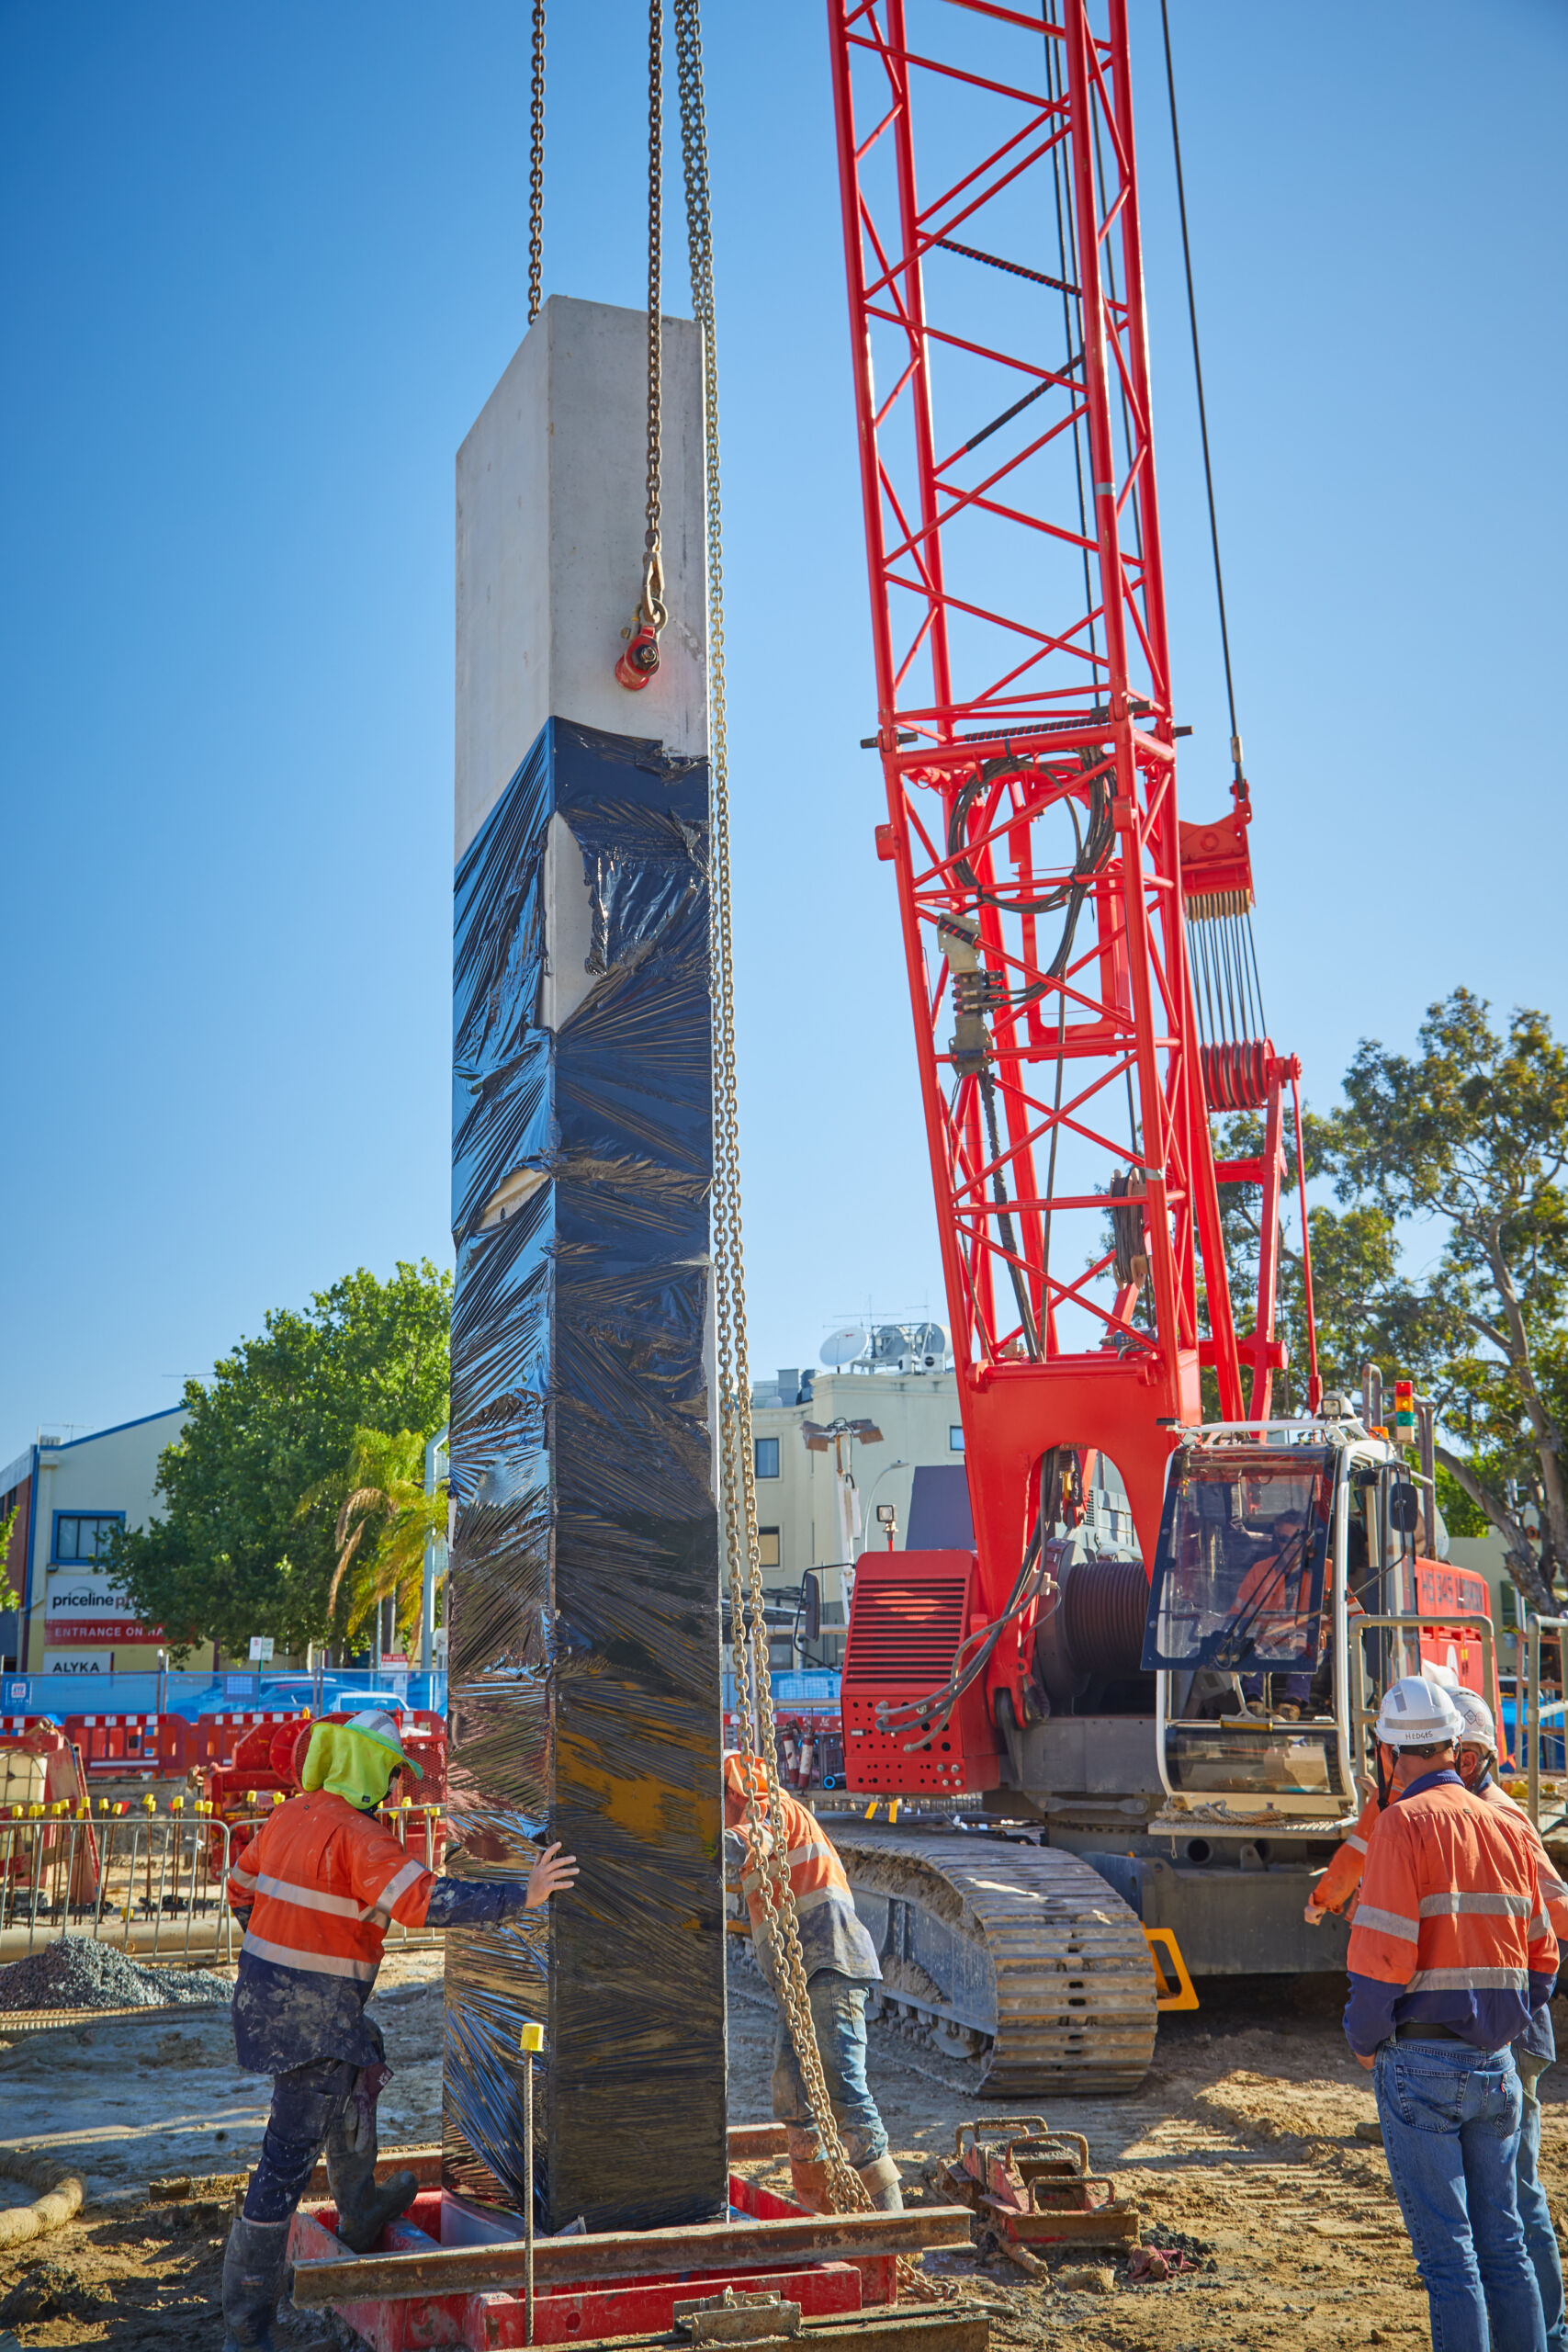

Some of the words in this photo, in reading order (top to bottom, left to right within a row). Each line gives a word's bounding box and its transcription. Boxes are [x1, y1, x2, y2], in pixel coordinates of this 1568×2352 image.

[52, 1592, 114, 1609] priceline
[54, 1626, 122, 1637] ENTRANCE
[125, 1626, 143, 1637] ON
[52, 1661, 100, 1673] ALYKA
[1404, 1730, 1434, 1741] HEDGES
